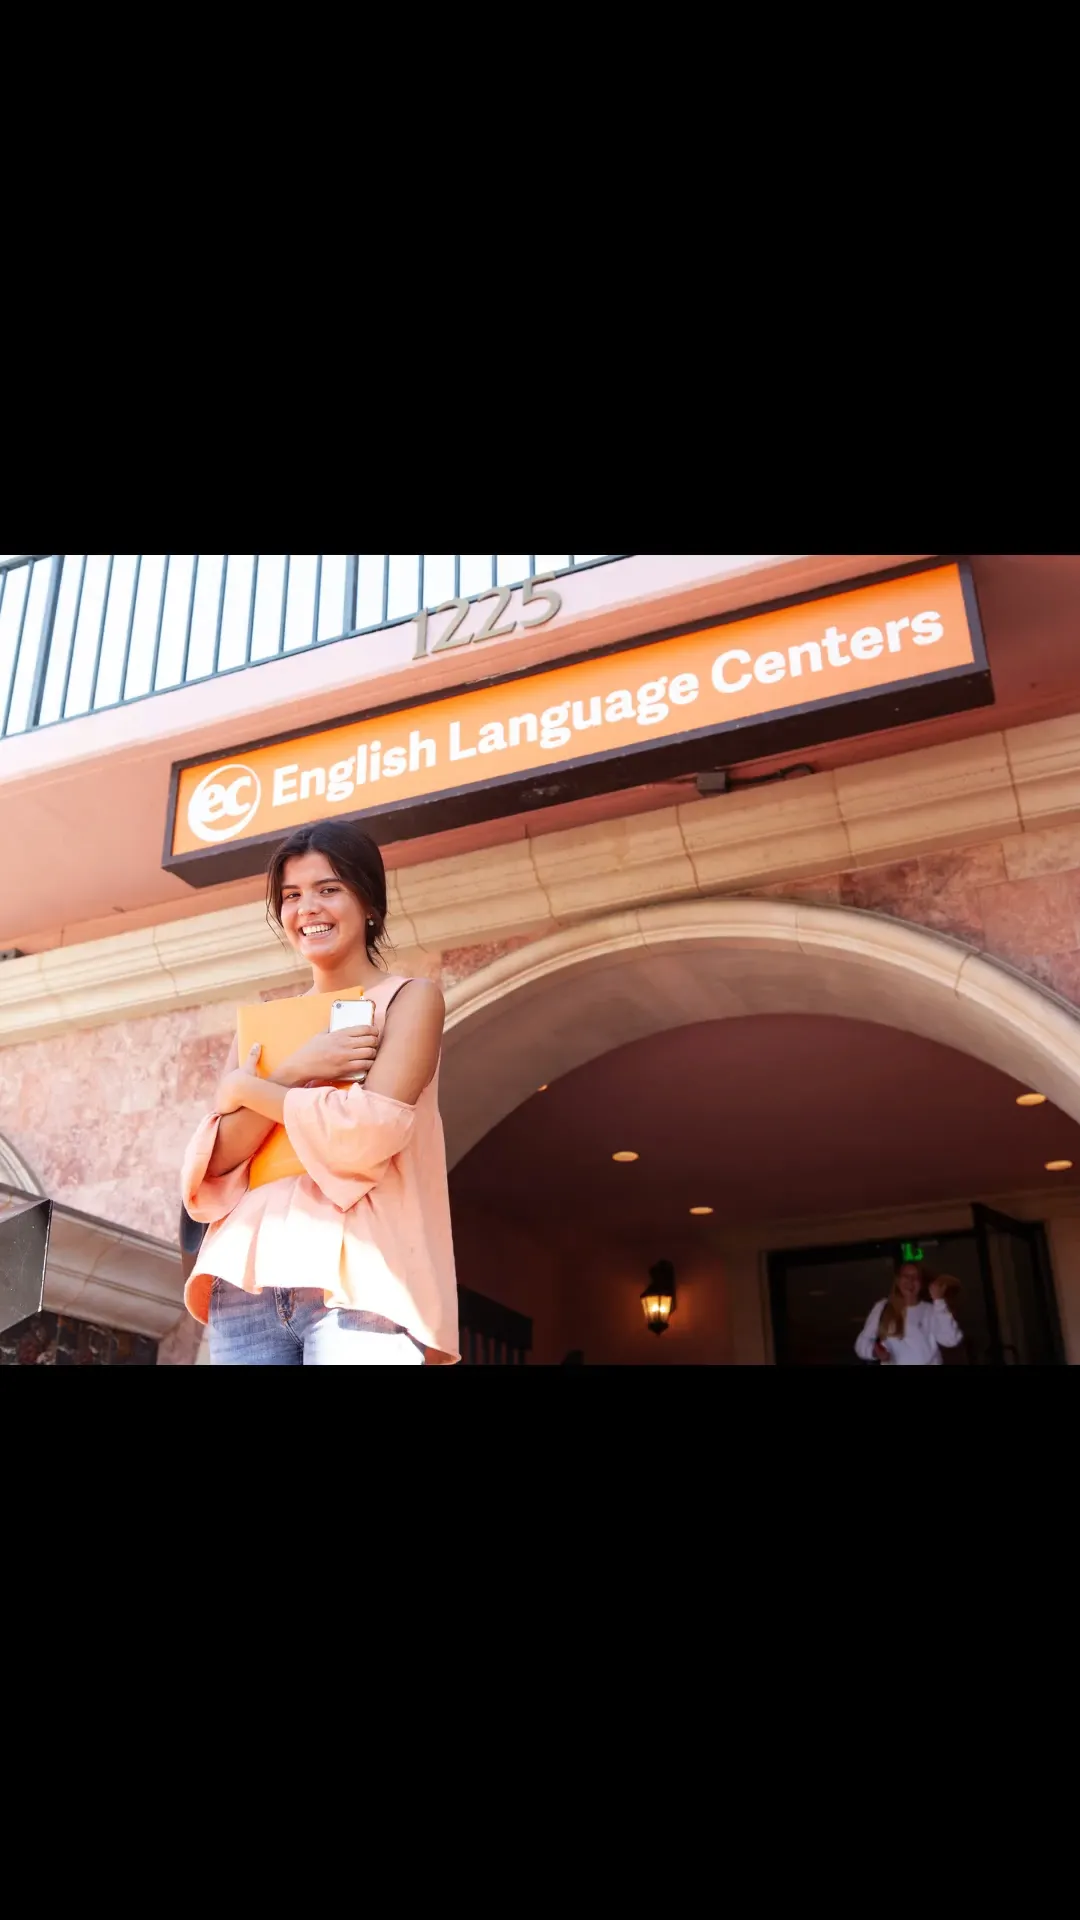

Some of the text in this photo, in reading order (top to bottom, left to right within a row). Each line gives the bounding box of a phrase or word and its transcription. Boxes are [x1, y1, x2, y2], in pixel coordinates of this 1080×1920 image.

[411, 570, 562, 660] 1225
[195, 610, 944, 824] ec English Language Centers
